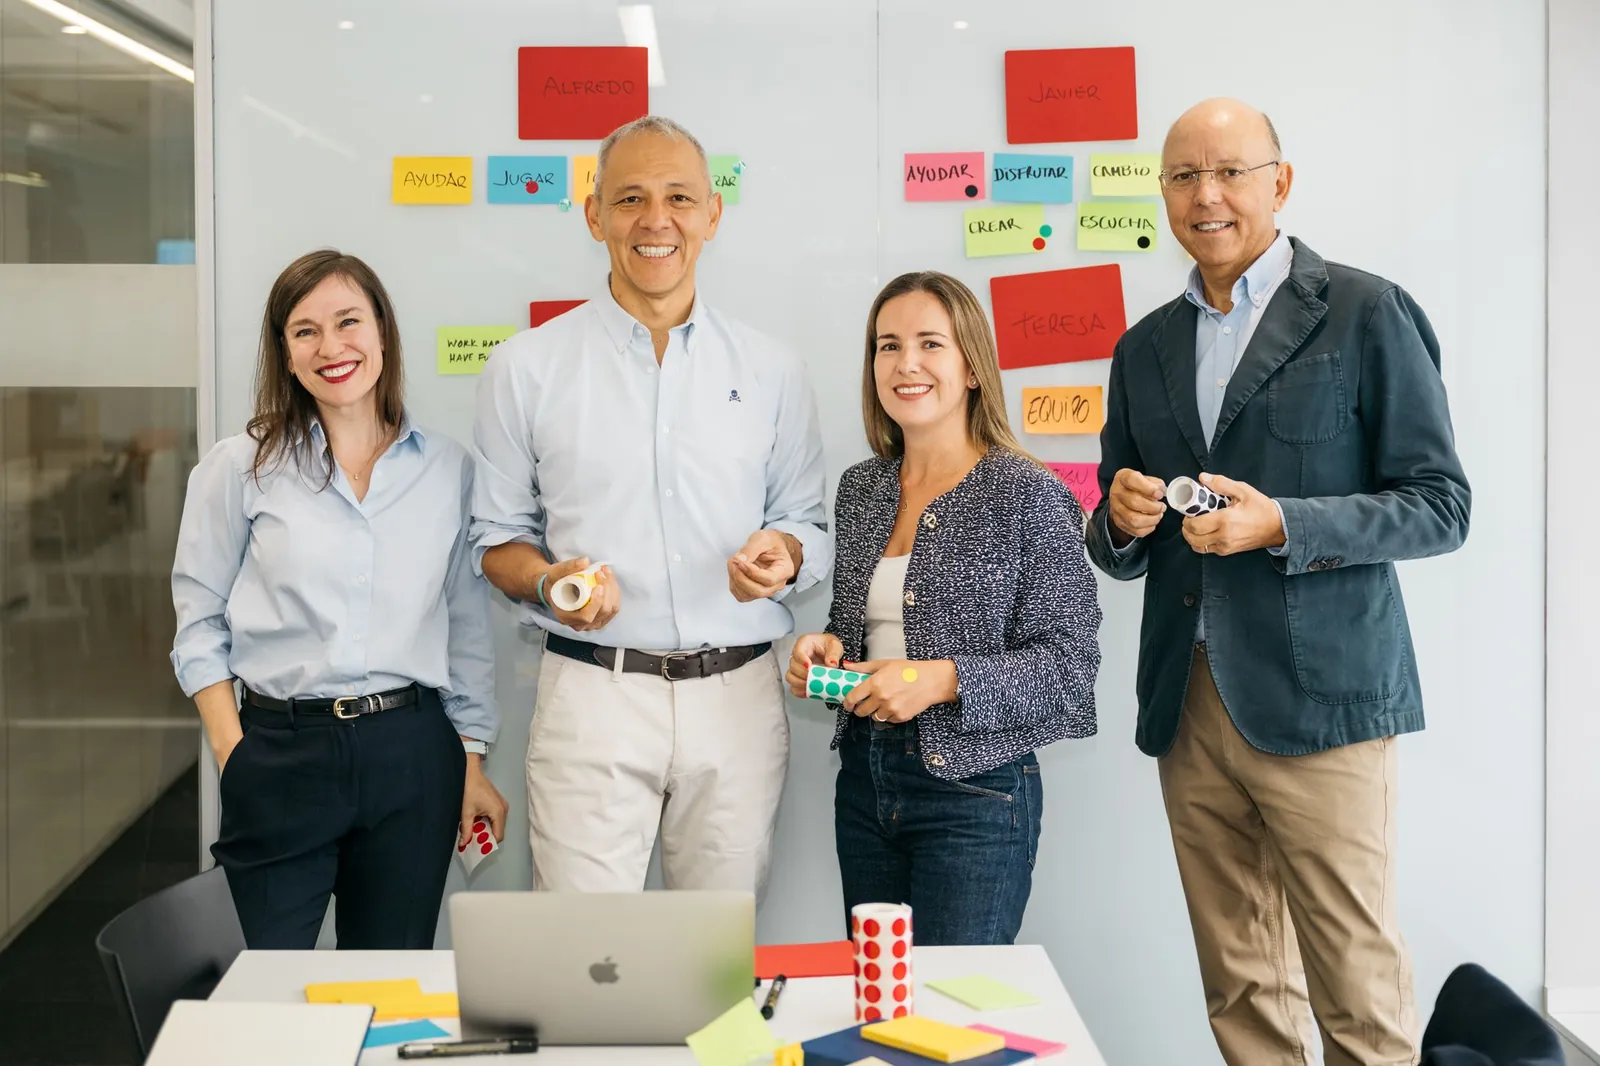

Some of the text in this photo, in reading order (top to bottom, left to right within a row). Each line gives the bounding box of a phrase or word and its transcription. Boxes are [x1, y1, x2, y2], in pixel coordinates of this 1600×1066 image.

[543, 75, 635, 99] ALFREDO
[1028, 82, 1102, 104] JAVIER
[403, 169, 468, 190] AYUDAR
[493, 170, 555, 187] JUGAR
[711, 174, 737, 188] ZAR
[906, 162, 974, 184] AYUDAR
[968, 217, 1024, 235] CREAR
[1079, 214, 1157, 232] ESCUCHA
[1011, 311, 1107, 340] TERESA
[447, 338, 478, 349] WORK
[449, 352, 474, 364] HAVE
